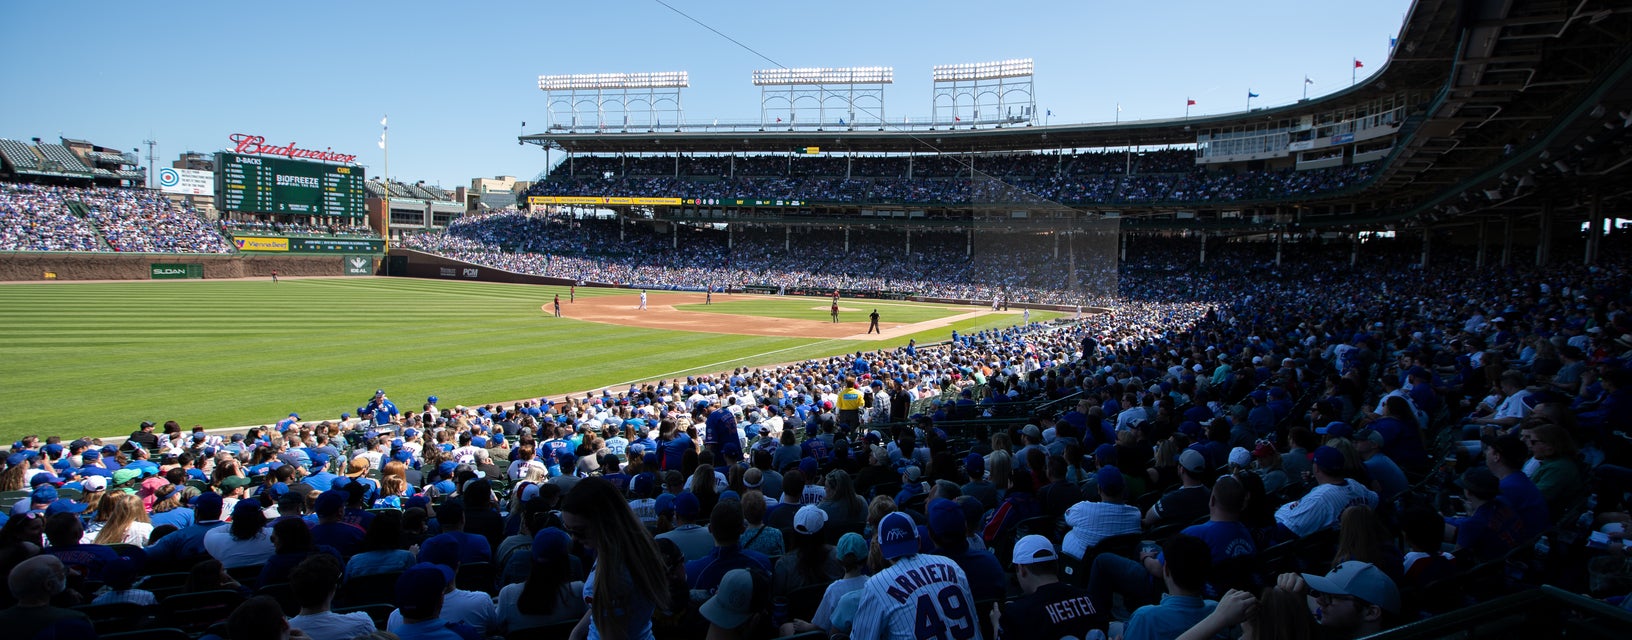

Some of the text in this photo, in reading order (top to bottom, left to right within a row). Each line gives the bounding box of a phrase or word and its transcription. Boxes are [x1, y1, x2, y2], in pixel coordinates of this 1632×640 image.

[229, 133, 356, 162] Budweiser
[235, 157, 262, 165] D-BACKS
[272, 241, 287, 249] Beef
[887, 563, 959, 605] ARRIETA
[914, 585, 975, 640] 49
[1045, 594, 1097, 625] HESTER
